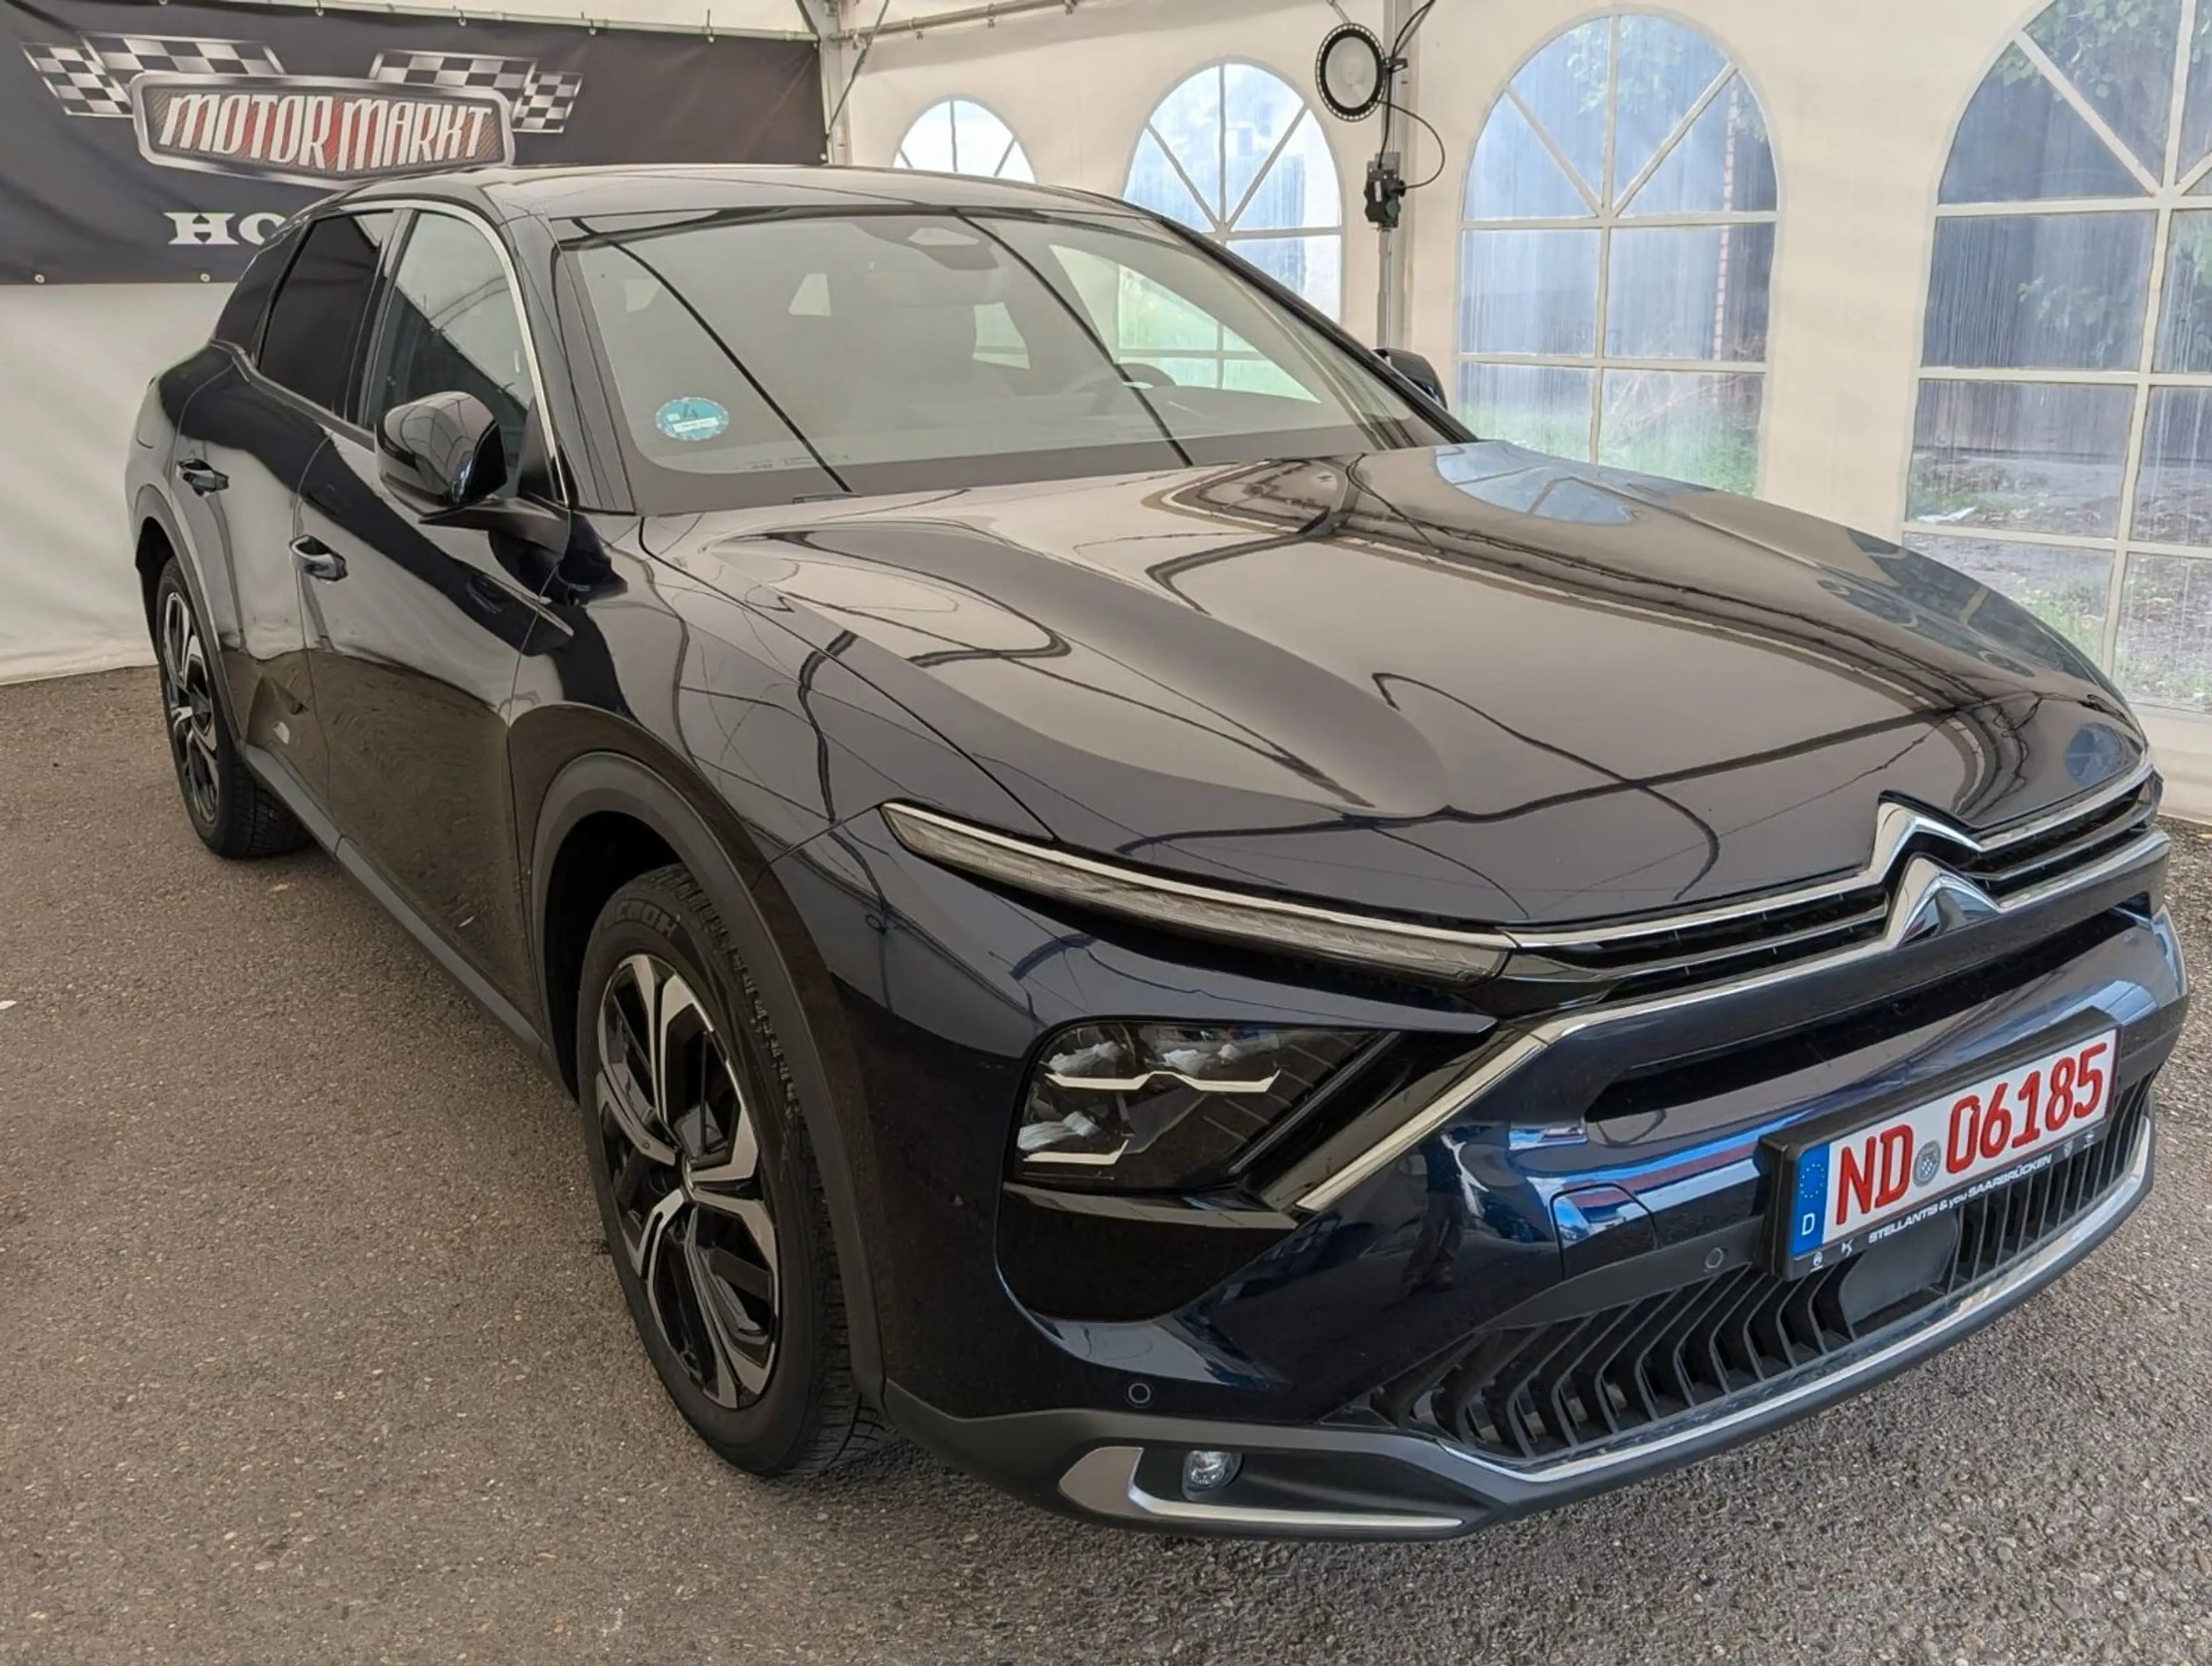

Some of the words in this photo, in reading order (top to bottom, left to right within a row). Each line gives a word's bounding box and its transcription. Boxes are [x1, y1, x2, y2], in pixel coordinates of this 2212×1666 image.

[159, 94, 334, 169] MOTOR
[337, 98, 492, 171] MARKT
[1836, 1124, 1913, 1225] ND
[1946, 1042, 2107, 1175] 06185
[1801, 1213, 1815, 1236] D
[1868, 1203, 1938, 1244] STELLANTIS
[1938, 1199, 1949, 1211] &
[1948, 1191, 1968, 1209] you
[1967, 1154, 2052, 1198] SAARBRÜCKEN
